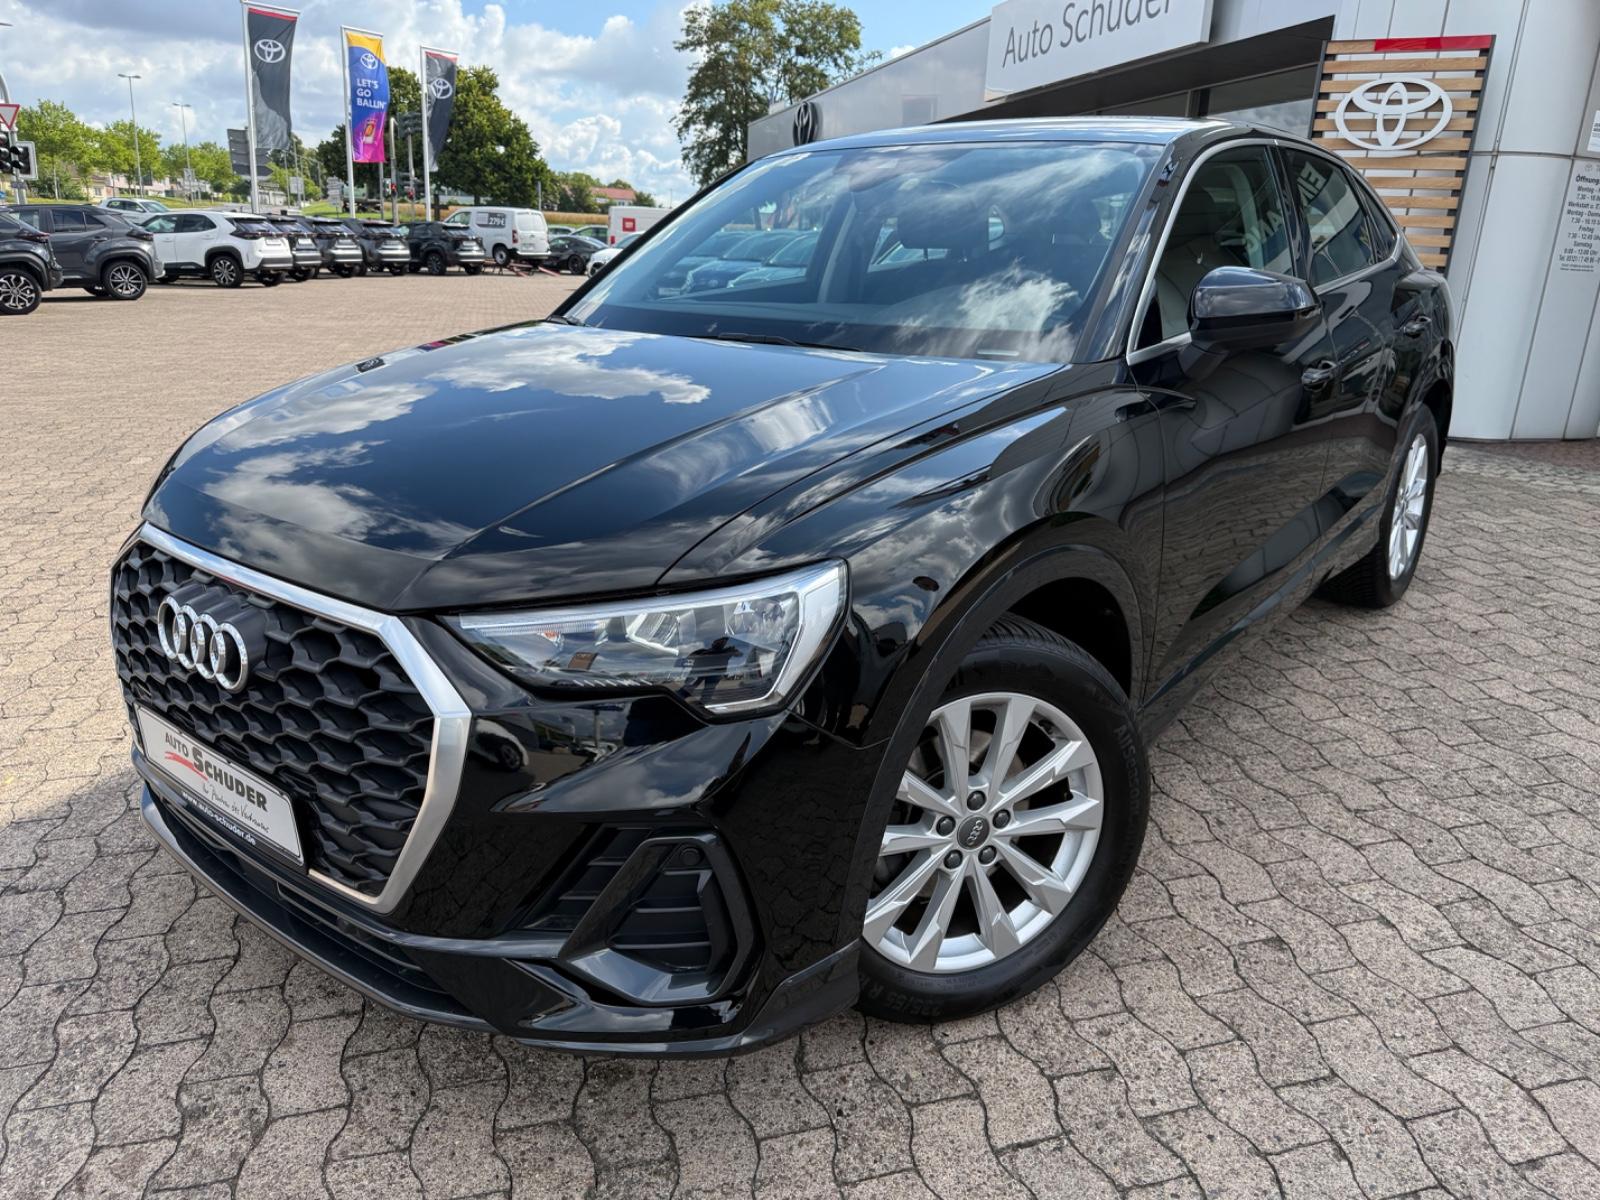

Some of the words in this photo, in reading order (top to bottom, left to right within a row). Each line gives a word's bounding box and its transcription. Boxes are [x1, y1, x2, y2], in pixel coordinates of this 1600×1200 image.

[1003, 20, 1053, 68] Auto
[357, 78, 379, 89] LET'S
[357, 88, 371, 97] GO
[1576, 174, 1600, 185] Öffnung
[165, 733, 189, 758] AUTO
[192, 746, 268, 812] SCHUDER
[181, 790, 256, 845] www.auto-schuder.de
